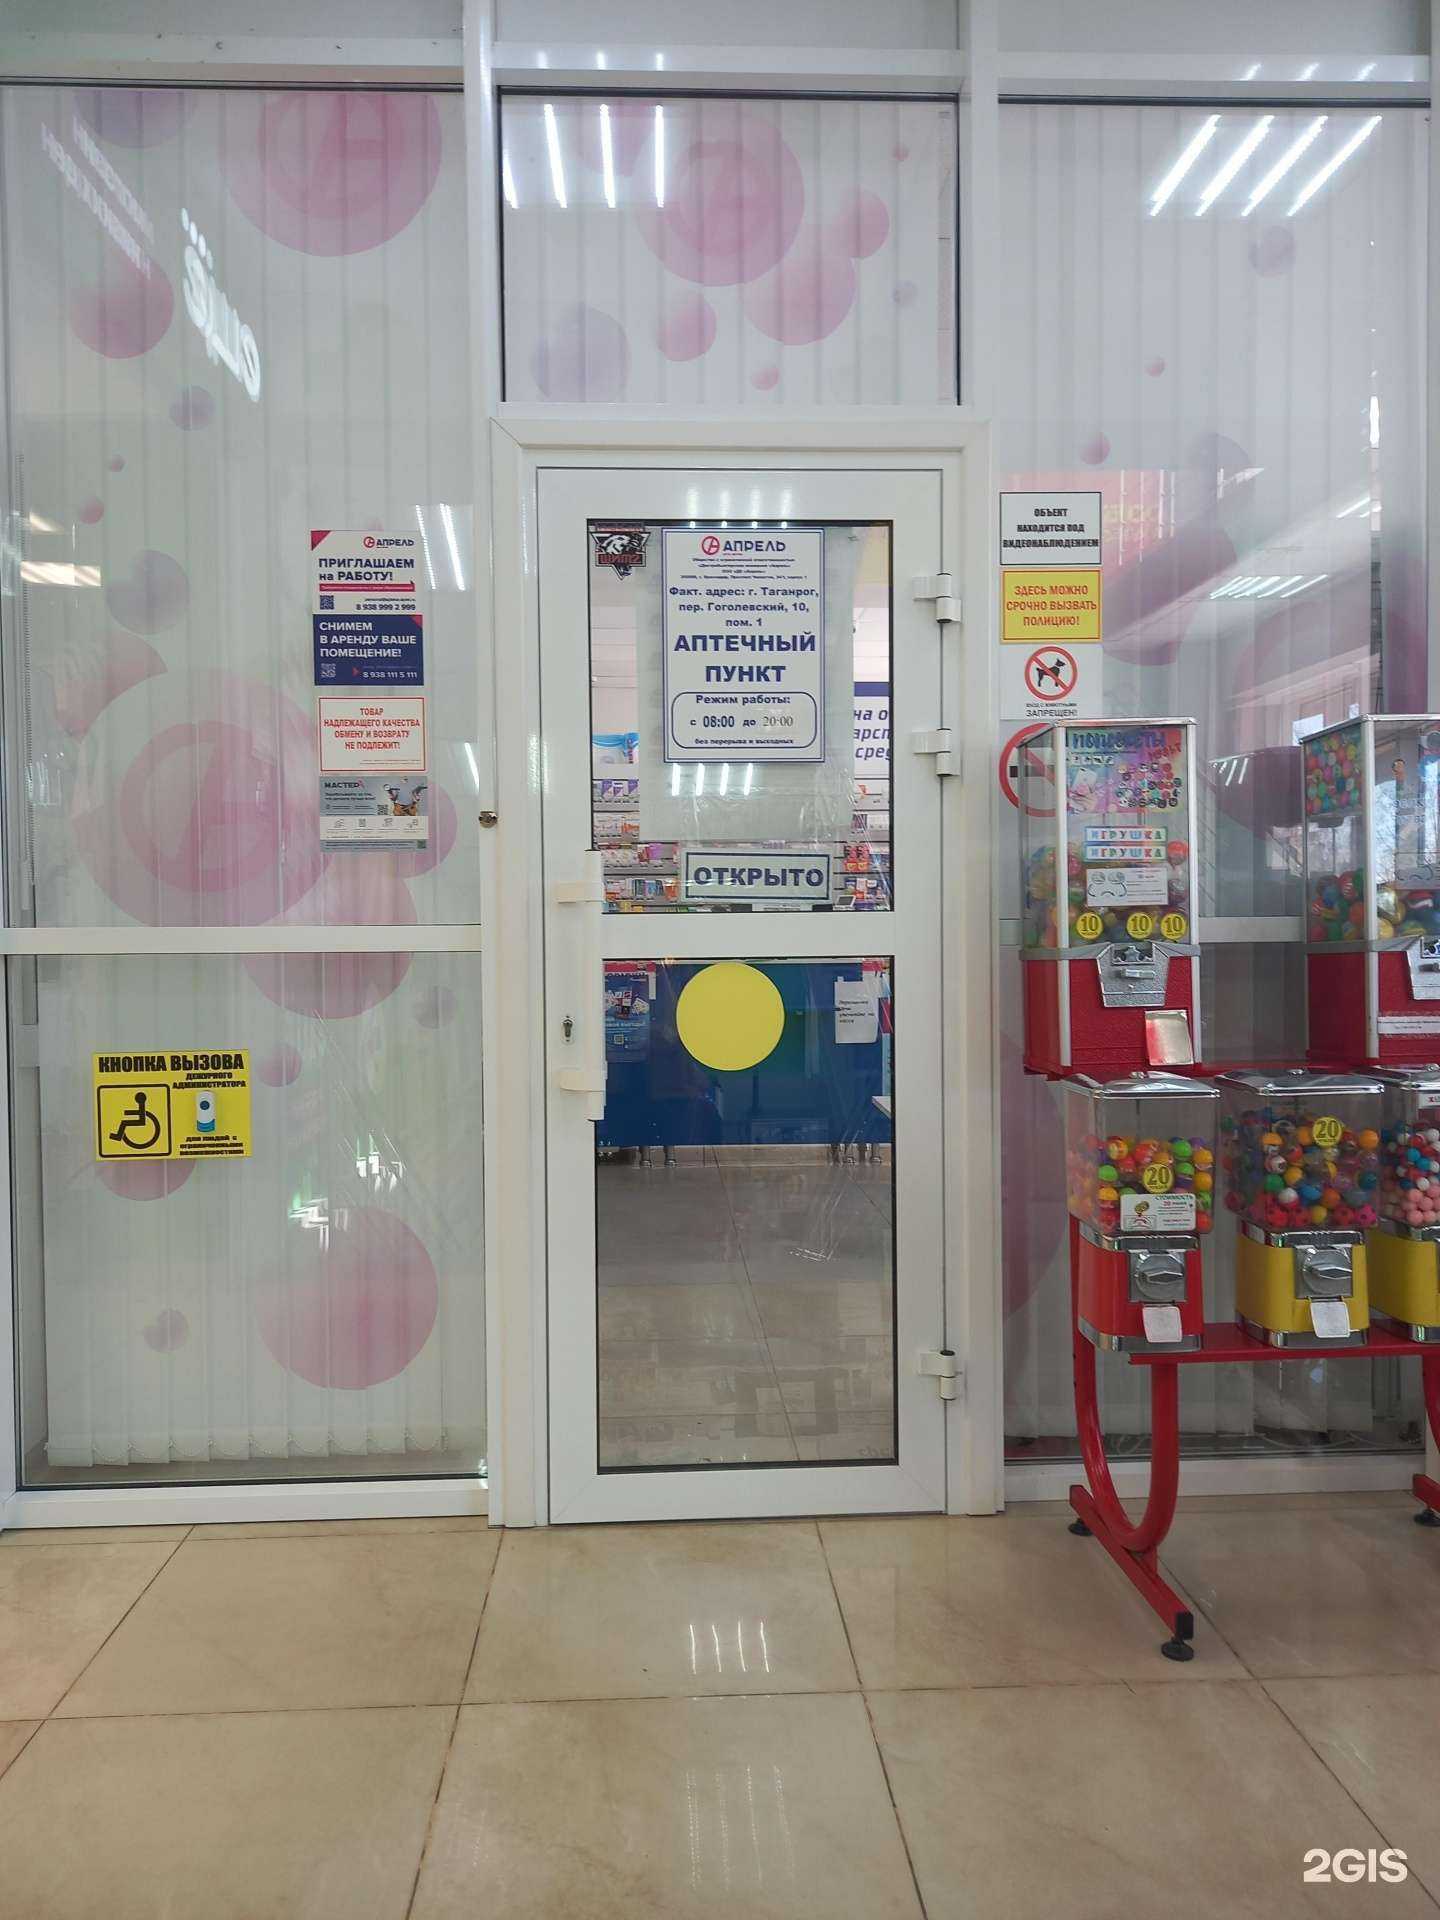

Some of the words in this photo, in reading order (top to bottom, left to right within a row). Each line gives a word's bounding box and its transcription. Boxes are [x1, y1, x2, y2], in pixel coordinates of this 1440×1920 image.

[1034, 508, 1068, 517] ОБЪЕКТ
[1017, 524, 1065, 532] НАХОДИТСЯ
[376, 538, 415, 547] АПРЕЛЬ
[723, 540, 786, 552] АПРЕЛЬ
[1003, 539, 1099, 548] ВИДЕОНАБЛЮДЕНИЕМ
[319, 558, 415, 568] ПРИГЛАШАЕМ
[319, 573, 334, 581] на
[338, 572, 393, 581] РАБОТУ!
[669, 587, 702, 596] Факт.
[706, 588, 745, 598] адрес:
[761, 587, 819, 598] Таганрог,
[1014, 585, 1047, 596] ЗДЕСЬ
[1049, 585, 1088, 595] МОЖНО
[679, 604, 703, 613] пер.
[708, 602, 788, 612] Гоголевский,
[792, 603, 809, 612] 10,
[1006, 601, 1047, 611] СРОЧНО
[1049, 600, 1097, 611] ВЫЗВАТЬ
[319, 622, 373, 631] СНИМЕМ
[726, 619, 752, 627] пом.
[757, 619, 762, 627] 1
[1023, 616, 1080, 627] ПОЛИЦИЮ!
[320, 636, 328, 644] В
[331, 636, 378, 645] АРЕНДУ
[382, 635, 417, 644] ВАШЕ
[674, 631, 816, 652] АПТЕЧНЫЙ
[320, 649, 401, 658] ПОМЕЩЕНИЕ!
[705, 665, 787, 683] ПУНКТ
[696, 695, 739, 704] Режим
[742, 695, 791, 706] работы:
[360, 708, 384, 716] ТОВАР
[324, 719, 381, 728] НАДЛЕЖАЩЕГО
[382, 719, 420, 727] КАЧЕСТВА
[703, 716, 735, 728] 08:00
[742, 719, 756, 728] до
[762, 716, 793, 727] 20:00
[357, 742, 400, 750] ПОДЛЕЖИТ!
[1091, 830, 1162, 841] ИГРУШКА
[1091, 848, 1162, 858] ИГРУШКА
[693, 866, 825, 887] ОТКРЫТО
[1081, 915, 1098, 931] 10
[1131, 915, 1149, 931] 10
[1166, 916, 1183, 932] 10
[98, 1056, 167, 1072] КНОПКА
[170, 1054, 245, 1071] ВЫЗОВА
[1317, 1120, 1338, 1138] 20
[1147, 1167, 1170, 1185] 20
